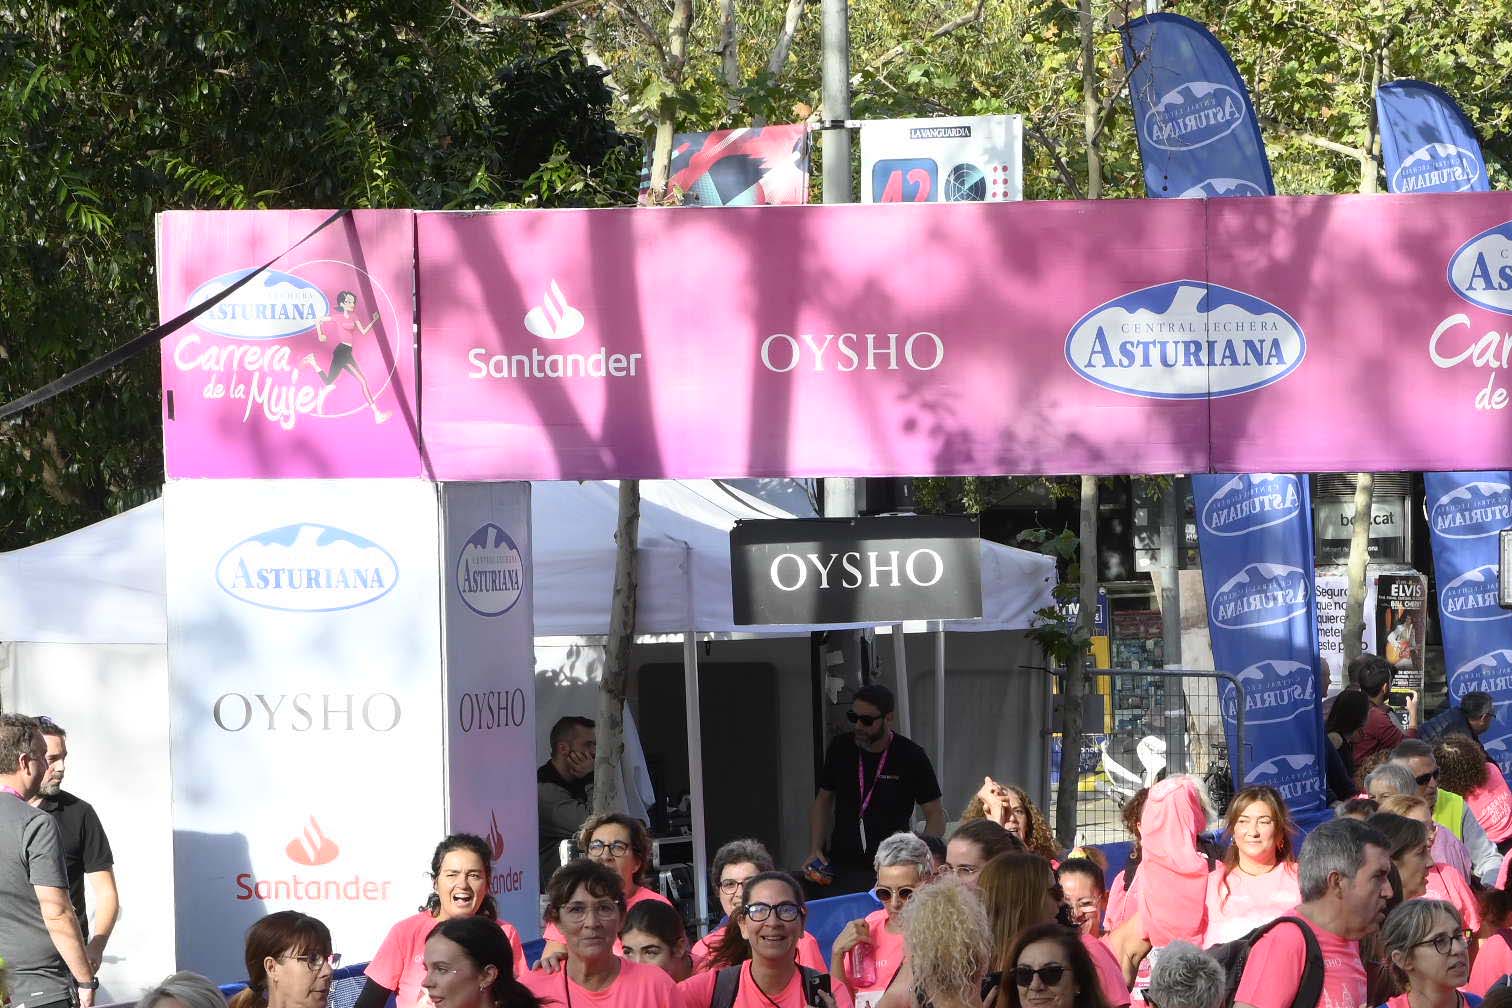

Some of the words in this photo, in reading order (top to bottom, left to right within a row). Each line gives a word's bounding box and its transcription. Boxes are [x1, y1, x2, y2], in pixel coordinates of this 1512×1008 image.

[1121, 320, 1198, 333] CENTRAL
[1203, 319, 1279, 332] LECHERA
[174, 336, 292, 371] Carrera
[469, 346, 642, 378] Santander
[761, 331, 944, 373] OYSHO
[1084, 325, 1286, 368] ASTURIANA
[203, 377, 225, 399] de
[230, 376, 246, 399] la
[243, 366, 336, 430] Mujer
[1475, 372, 1509, 410] de
[1341, 512, 1395, 526] b.cat
[232, 558, 386, 590] ASTURIANA
[462, 559, 520, 594] ASTURIANA
[770, 548, 944, 592] OYSHO
[1391, 584, 1422, 596] ELVIS
[214, 692, 400, 732] OYSHO
[459, 687, 526, 733] OYSHO
[236, 873, 391, 901] Santander
[489, 869, 524, 896] ander
